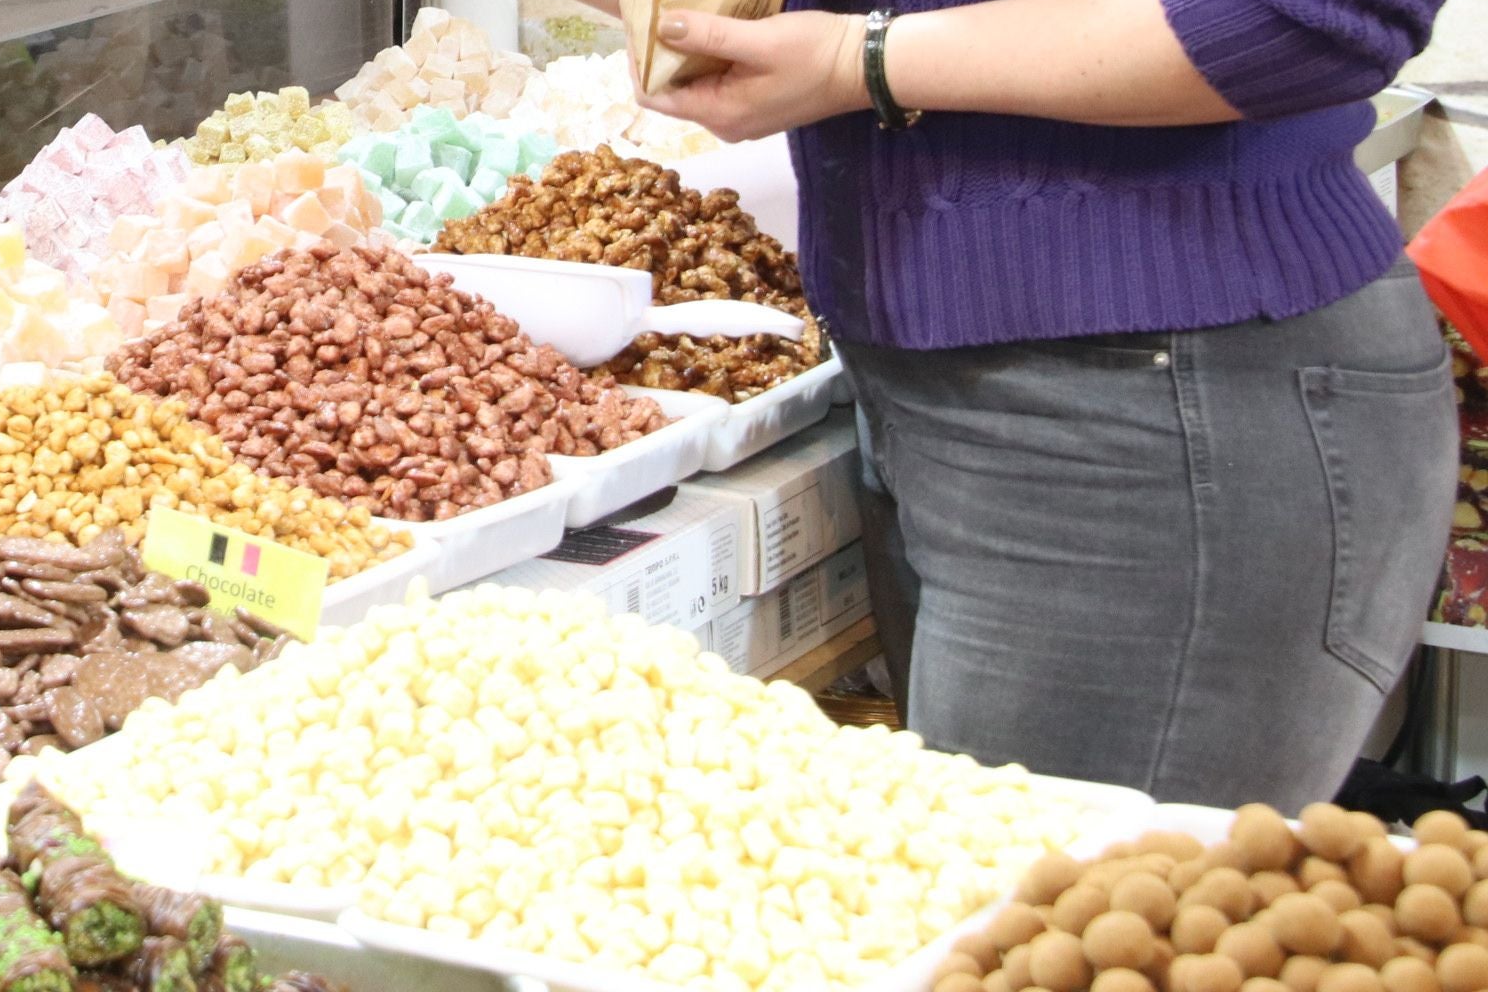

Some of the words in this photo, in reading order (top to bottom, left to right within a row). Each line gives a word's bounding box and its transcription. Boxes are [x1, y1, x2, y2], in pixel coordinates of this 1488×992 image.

[185, 564, 276, 609] Chocolate
[711, 577, 717, 596] 5
[718, 574, 729, 594] kg
